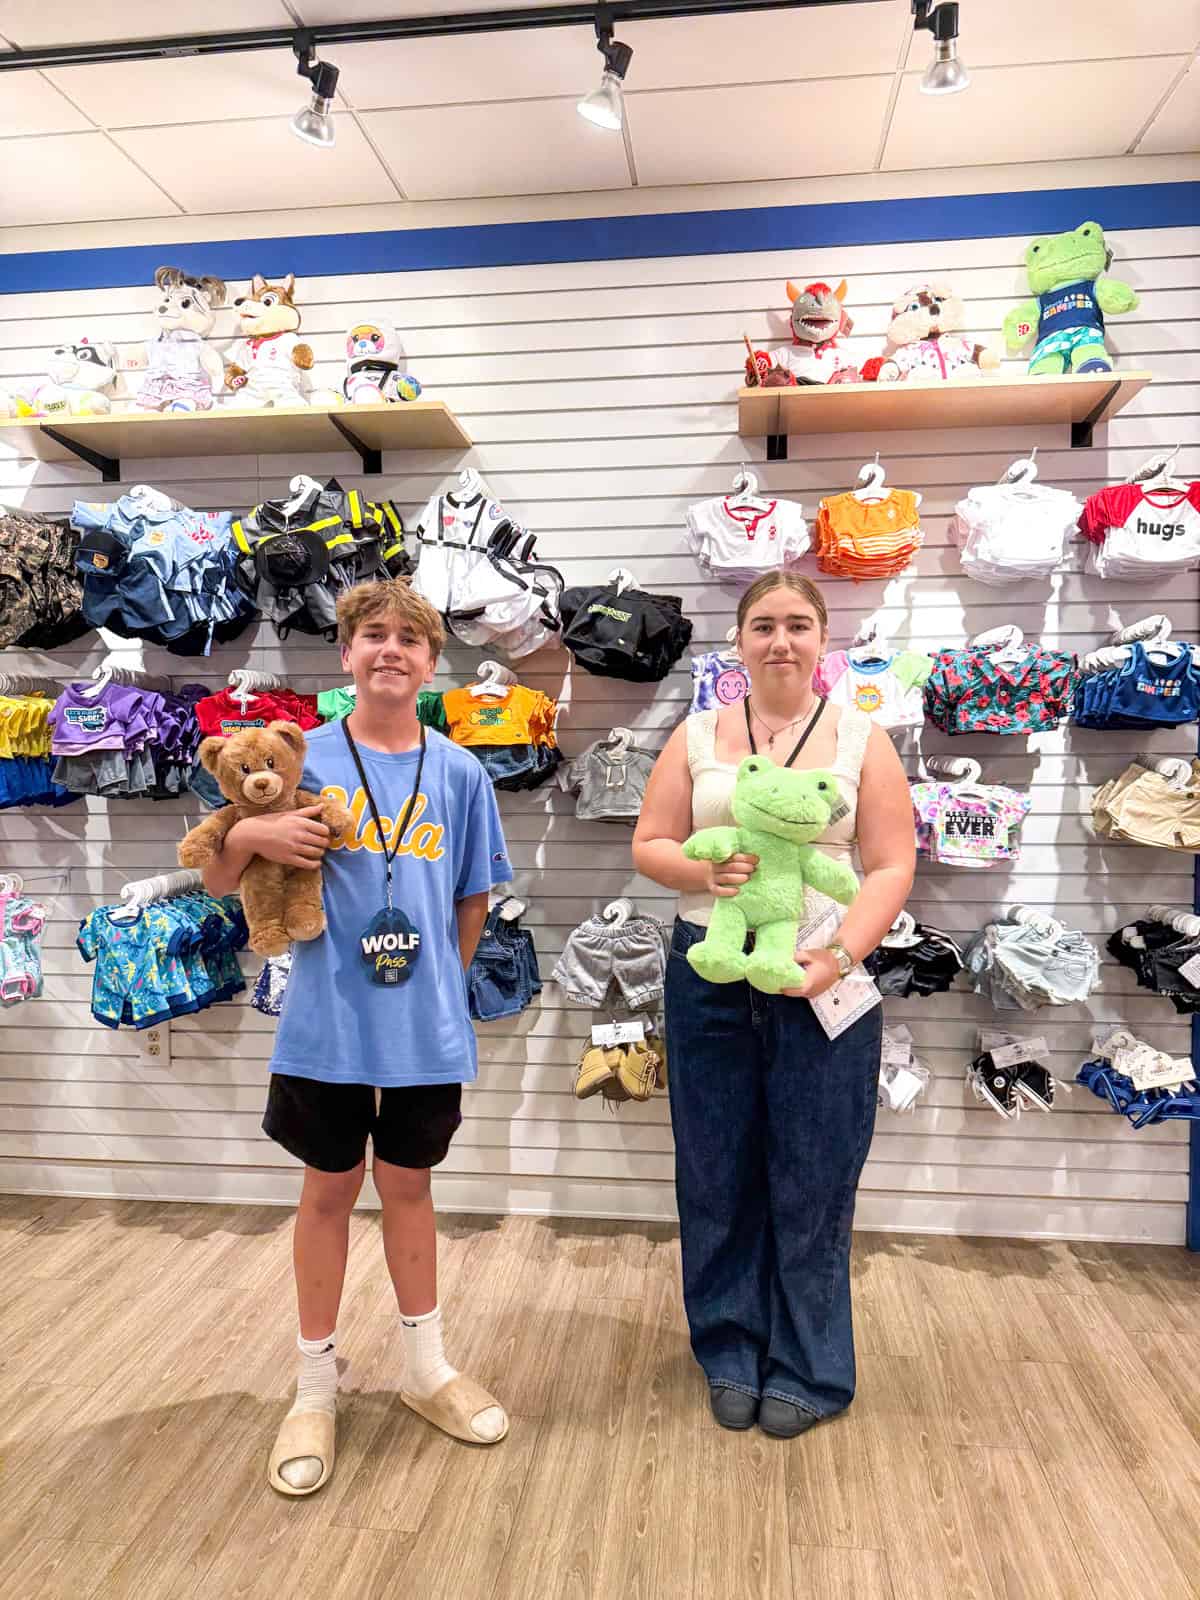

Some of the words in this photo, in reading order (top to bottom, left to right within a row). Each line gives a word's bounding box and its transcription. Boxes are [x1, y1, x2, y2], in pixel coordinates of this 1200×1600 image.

[1136, 517, 1186, 541] hugs
[1137, 682, 1181, 697] CMPER
[945, 821, 995, 836] EVER
[361, 932, 420, 955] WOLF
[375, 953, 408, 972] Pass
